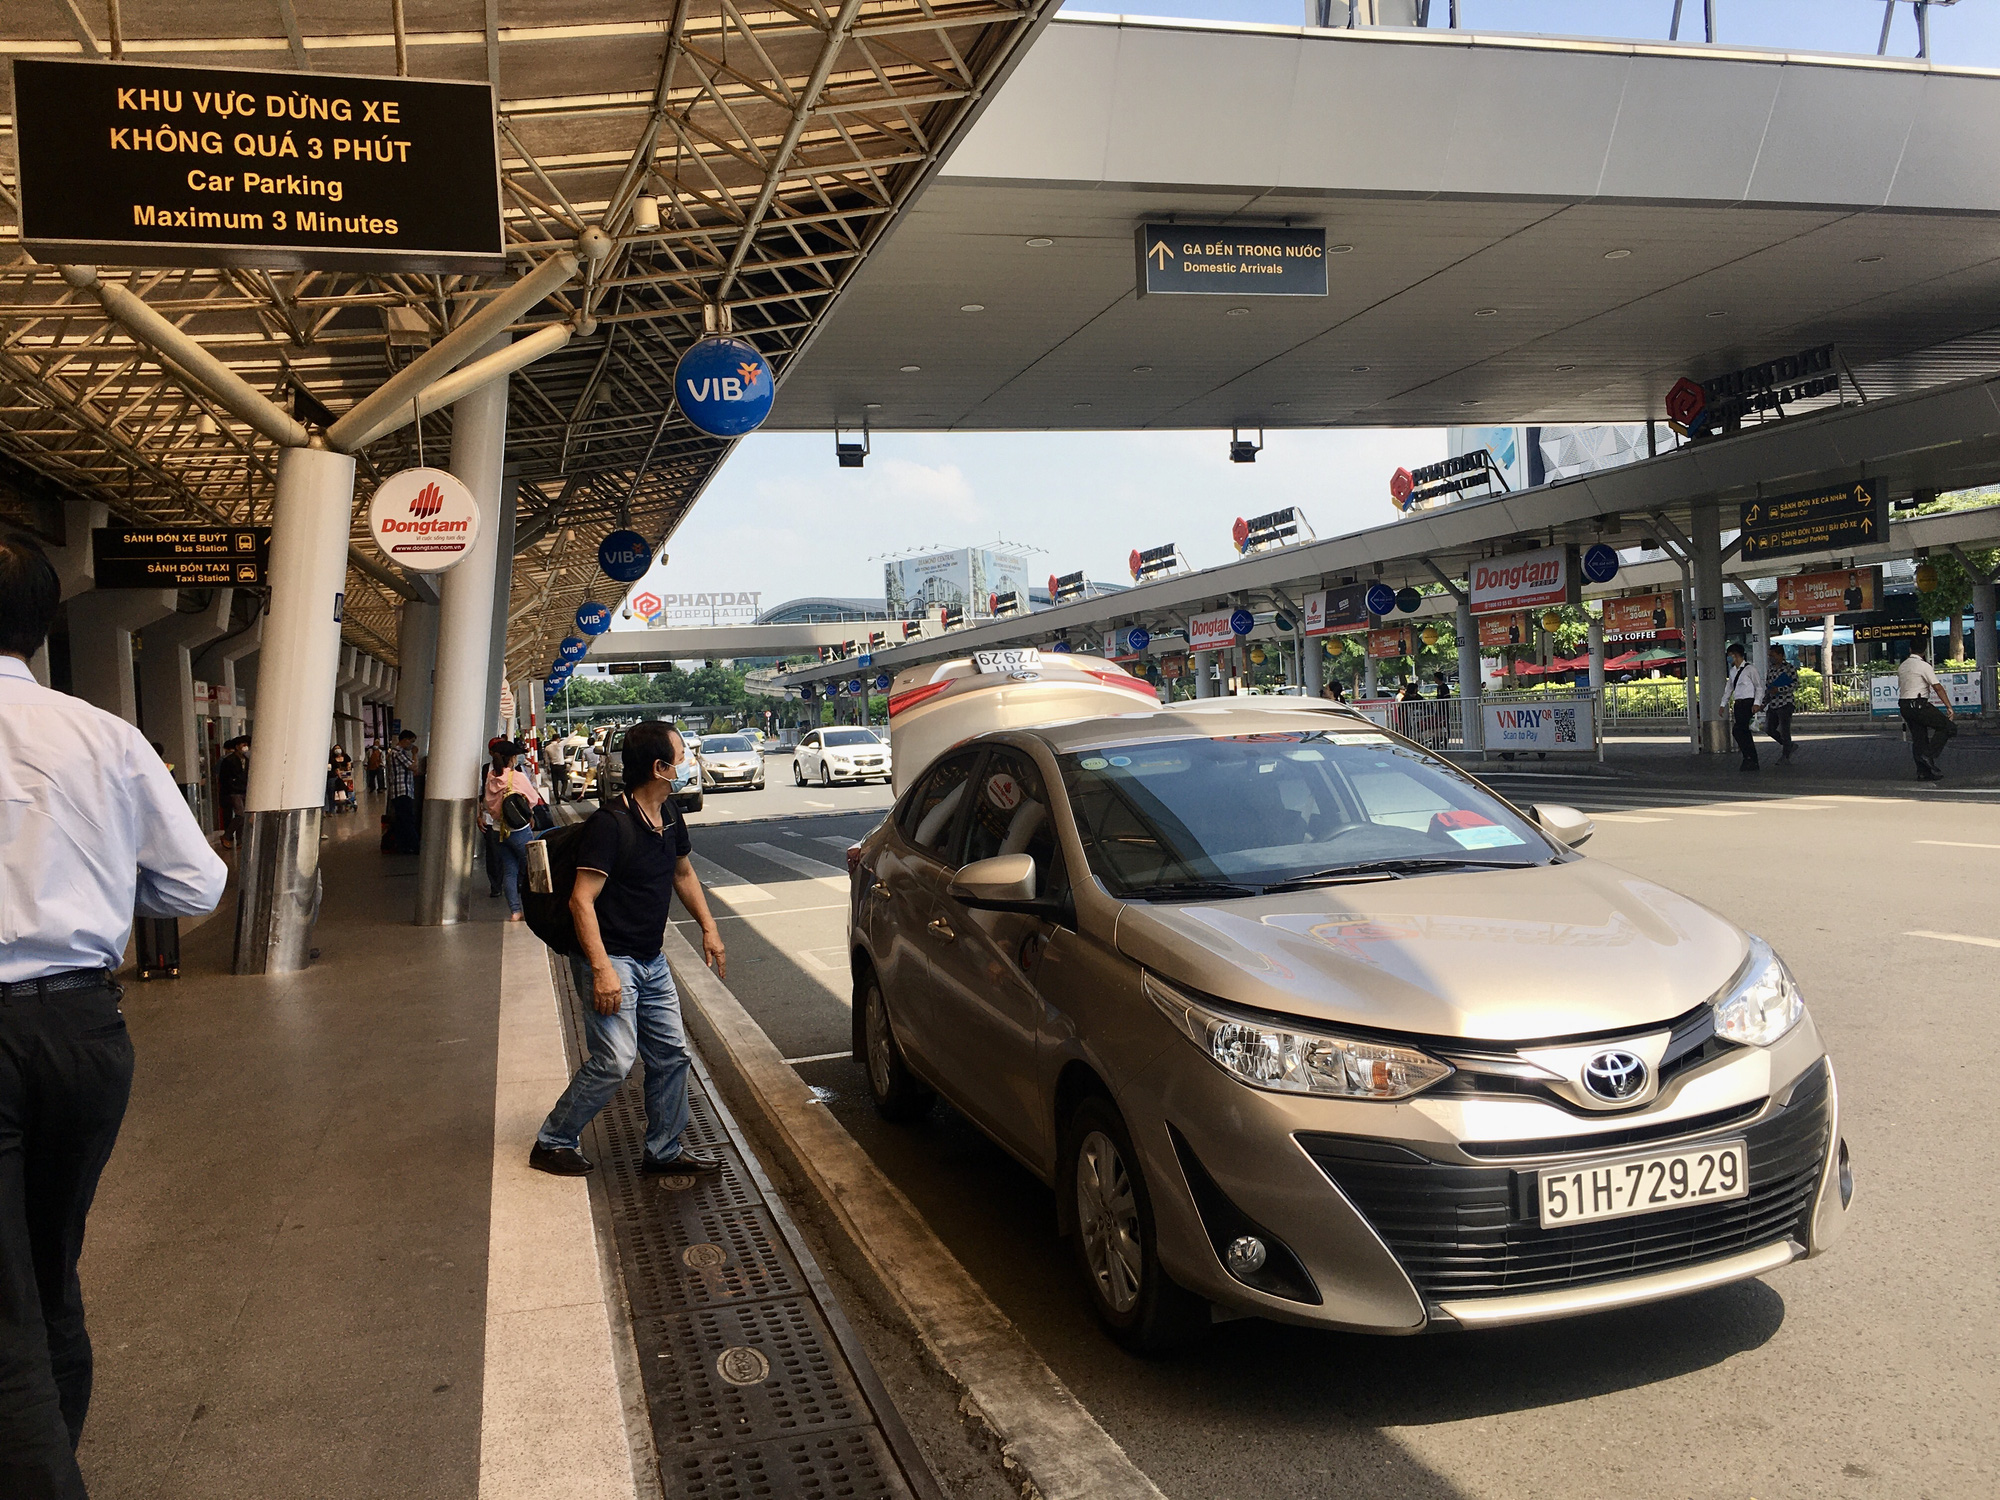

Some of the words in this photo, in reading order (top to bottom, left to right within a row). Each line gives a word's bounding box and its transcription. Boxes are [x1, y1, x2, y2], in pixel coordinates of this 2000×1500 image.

[117, 87, 183, 113] KHU
[193, 90, 256, 120] VỰC
[266, 90, 352, 122] DỪNG
[362, 100, 401, 123] XE
[110, 124, 223, 154] KHÔNG
[233, 130, 299, 158] QUÁ
[307, 138, 324, 159] 3
[333, 135, 412, 163] PHÚT
[187, 170, 235, 192] Car
[243, 172, 343, 202] Parking
[133, 205, 264, 230] Maximum
[272, 210, 287, 231] 3
[296, 211, 399, 235] Minutes
[1183, 243, 1202, 255] GA
[1206, 240, 1233, 256] ĐẾN
[1236, 244, 1282, 257] TRONG
[1285, 243, 1322, 258] NƯỚC
[1183, 261, 1237, 273] Domestic
[1240, 262, 1283, 274] Arrivals
[686, 377, 744, 402] VIB
[1411, 448, 1487, 486] PHATDAT
[1779, 502, 1797, 511] SẢNH
[1797, 499, 1811, 508] ĐÓN
[1811, 497, 1820, 505] XE
[1820, 495, 1829, 504] CÁ
[1829, 493, 1847, 502] NHÂN
[1780, 511, 1798, 519] Private
[381, 518, 468, 536] Dongtam
[1781, 528, 1797, 539] SẢNH
[1797, 527, 1811, 537] ĐÓN
[1811, 525, 1825, 534] TAXI
[1849, 520, 1858, 528] XE
[123, 532, 154, 543] SẢNH
[156, 532, 180, 543] ĐÓN
[182, 534, 197, 543] XE
[199, 532, 228, 542] BUÝT
[1781, 539, 1792, 547] Taxi
[1809, 534, 1829, 544] Parking
[174, 545, 194, 553] Bus
[195, 544, 228, 553] Station
[395, 544, 462, 552] www.dongtam.com.vn
[605, 550, 635, 564] VIB
[147, 562, 178, 573] SẢNH
[180, 562, 203, 573] ĐÓN
[206, 564, 230, 572] TAXI
[175, 574, 195, 583] Taxi
[197, 574, 230, 582] Station
[1475, 560, 1560, 590] Dongtam
[664, 591, 762, 607] PHATDAT
[579, 614, 601, 625] VIB
[666, 607, 764, 619] CORPORATION
[1625, 631, 1656, 641] COFFEE
[562, 646, 578, 654] VIB
[1503, 730, 1518, 740] Scan
[1518, 730, 1525, 739] to
[1526, 730, 1538, 742] Pay
[1547, 1150, 1738, 1218] 51H-729.29
